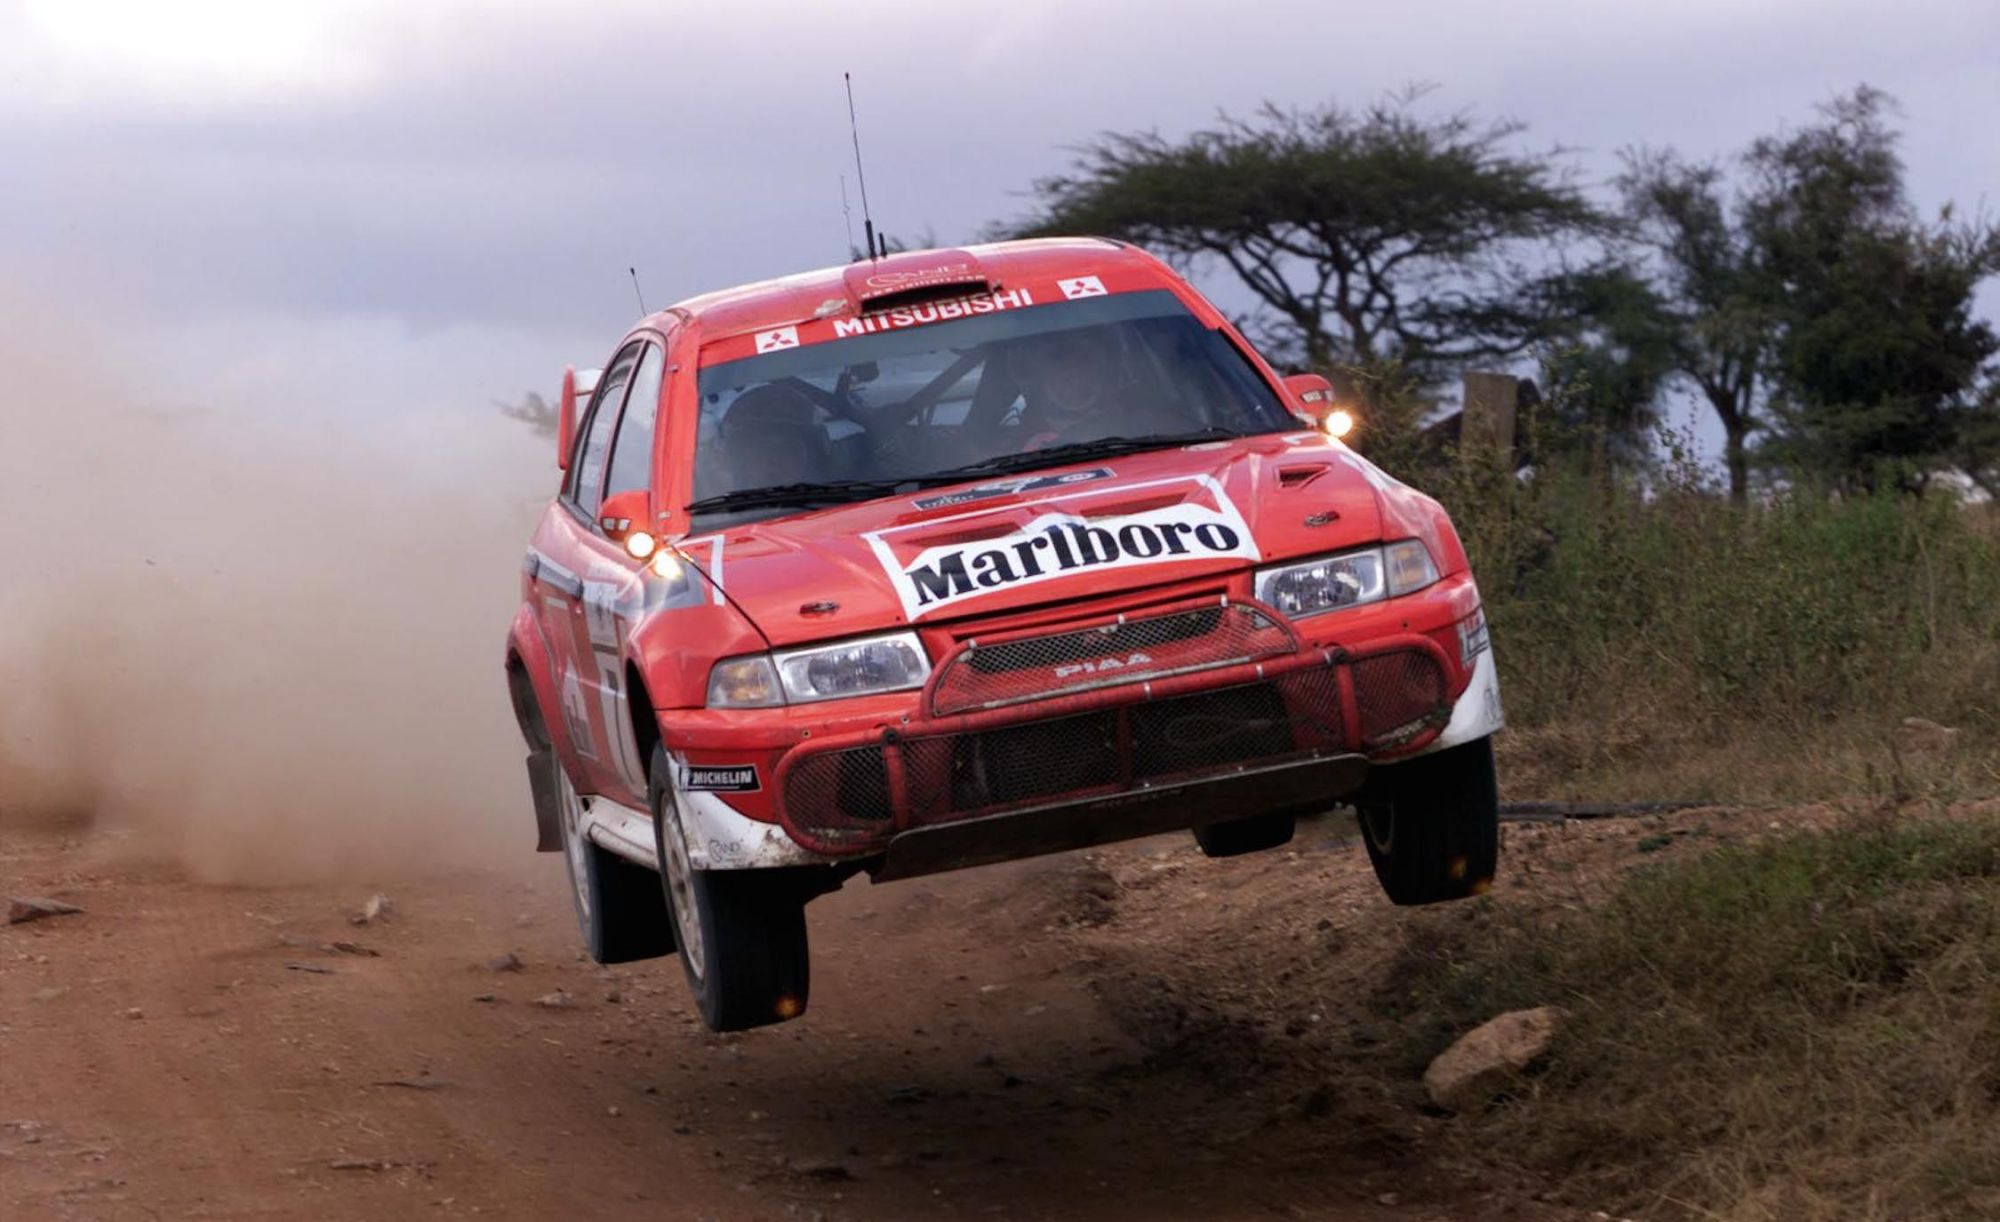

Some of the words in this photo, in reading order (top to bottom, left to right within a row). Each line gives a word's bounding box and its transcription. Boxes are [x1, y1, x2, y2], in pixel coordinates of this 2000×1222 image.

[832, 287, 1034, 338] MITSUBISHI
[905, 520, 1240, 606] Marlboro
[1053, 652, 1153, 678] PIAA
[692, 770, 753, 785] MICHELIN
